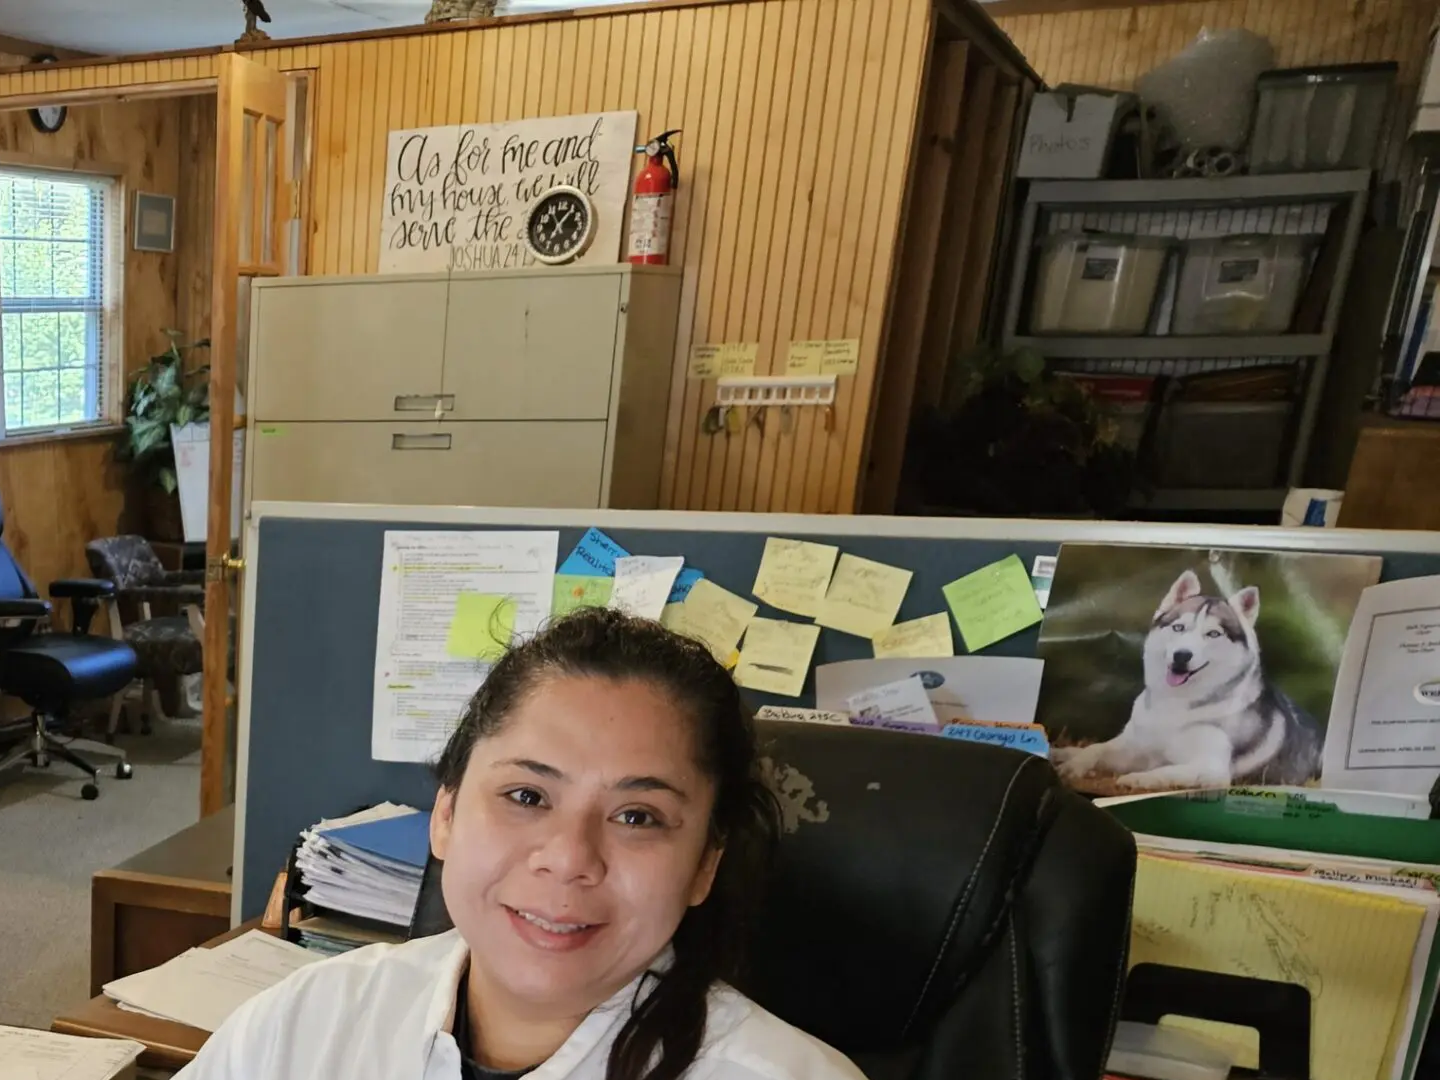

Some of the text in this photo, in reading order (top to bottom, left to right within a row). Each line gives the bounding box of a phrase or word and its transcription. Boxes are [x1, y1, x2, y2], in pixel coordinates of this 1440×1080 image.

[397, 117, 603, 186] As for me and
[391, 182, 434, 221] my
[516, 176, 544, 203] we
[390, 216, 456, 251] serve
[465, 207, 513, 242] the
[447, 244, 501, 272] JOSHUA
